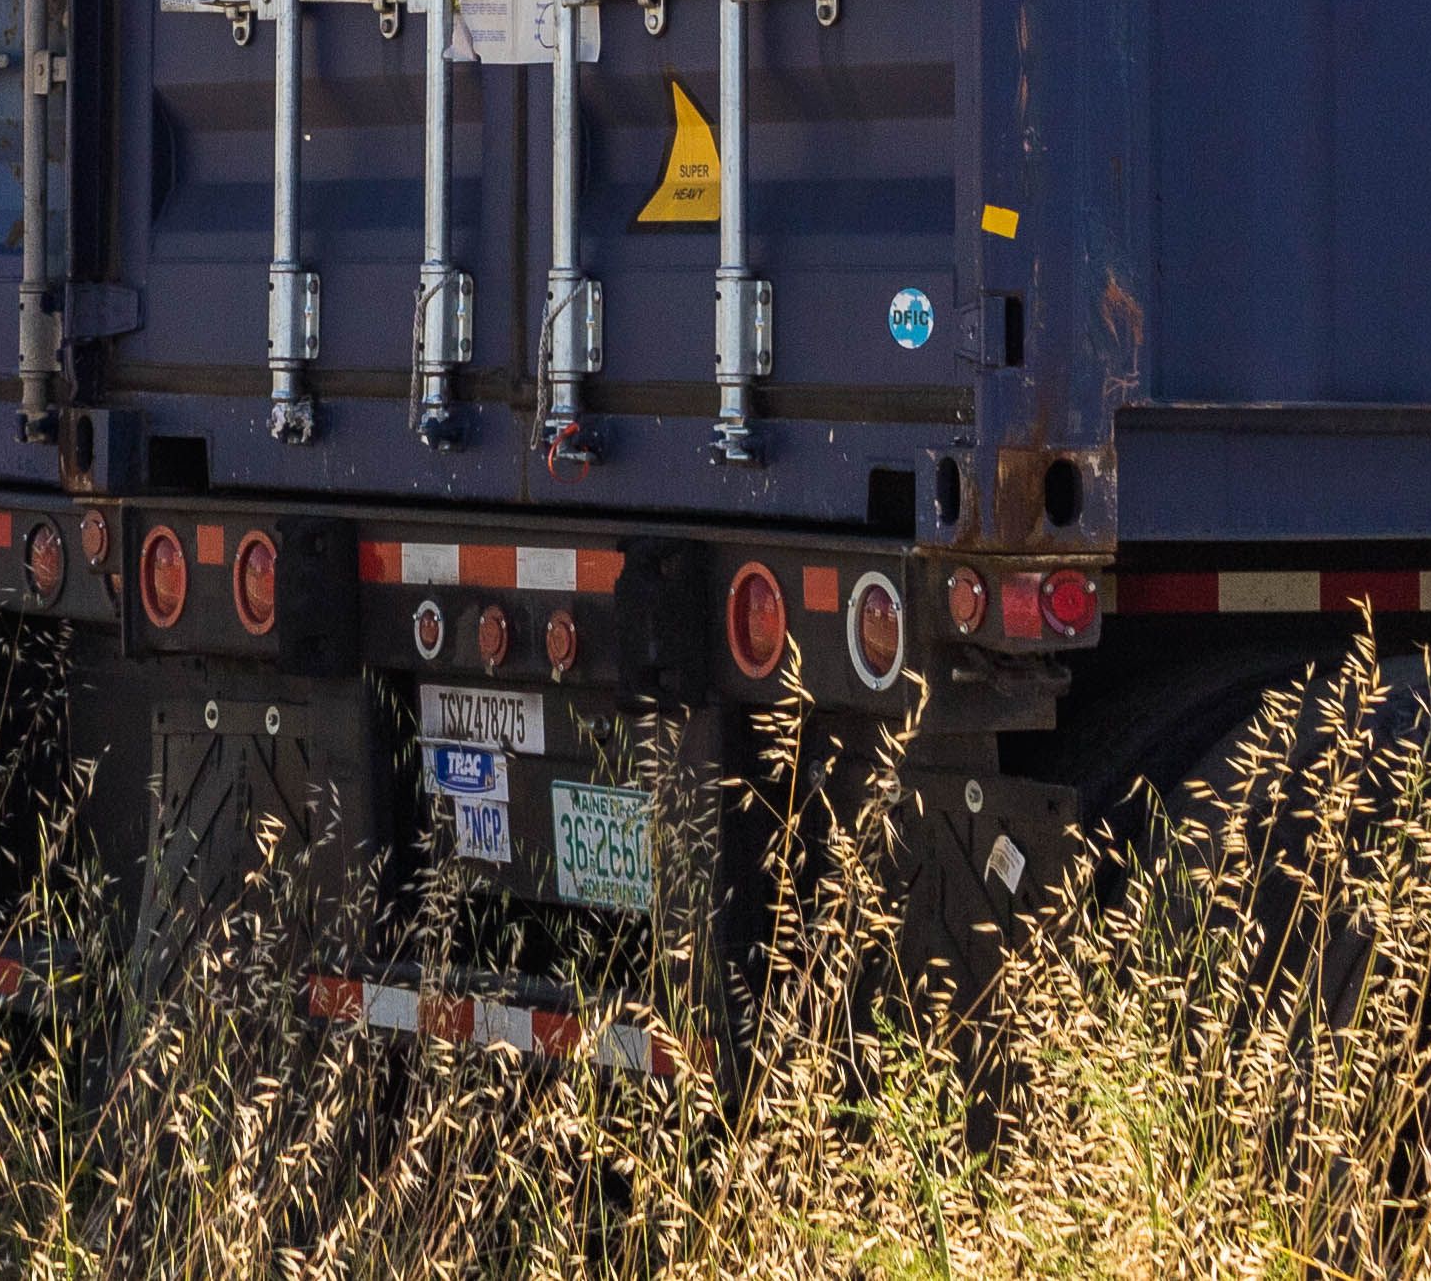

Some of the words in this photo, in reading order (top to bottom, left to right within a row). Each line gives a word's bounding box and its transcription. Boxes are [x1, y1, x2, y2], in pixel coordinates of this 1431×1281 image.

[679, 163, 710, 179] SUPER
[672, 186, 706, 202] HEAVY
[892, 309, 930, 329] DFIC
[439, 693, 525, 744] TSXZ478275
[447, 751, 482, 778] TRAC
